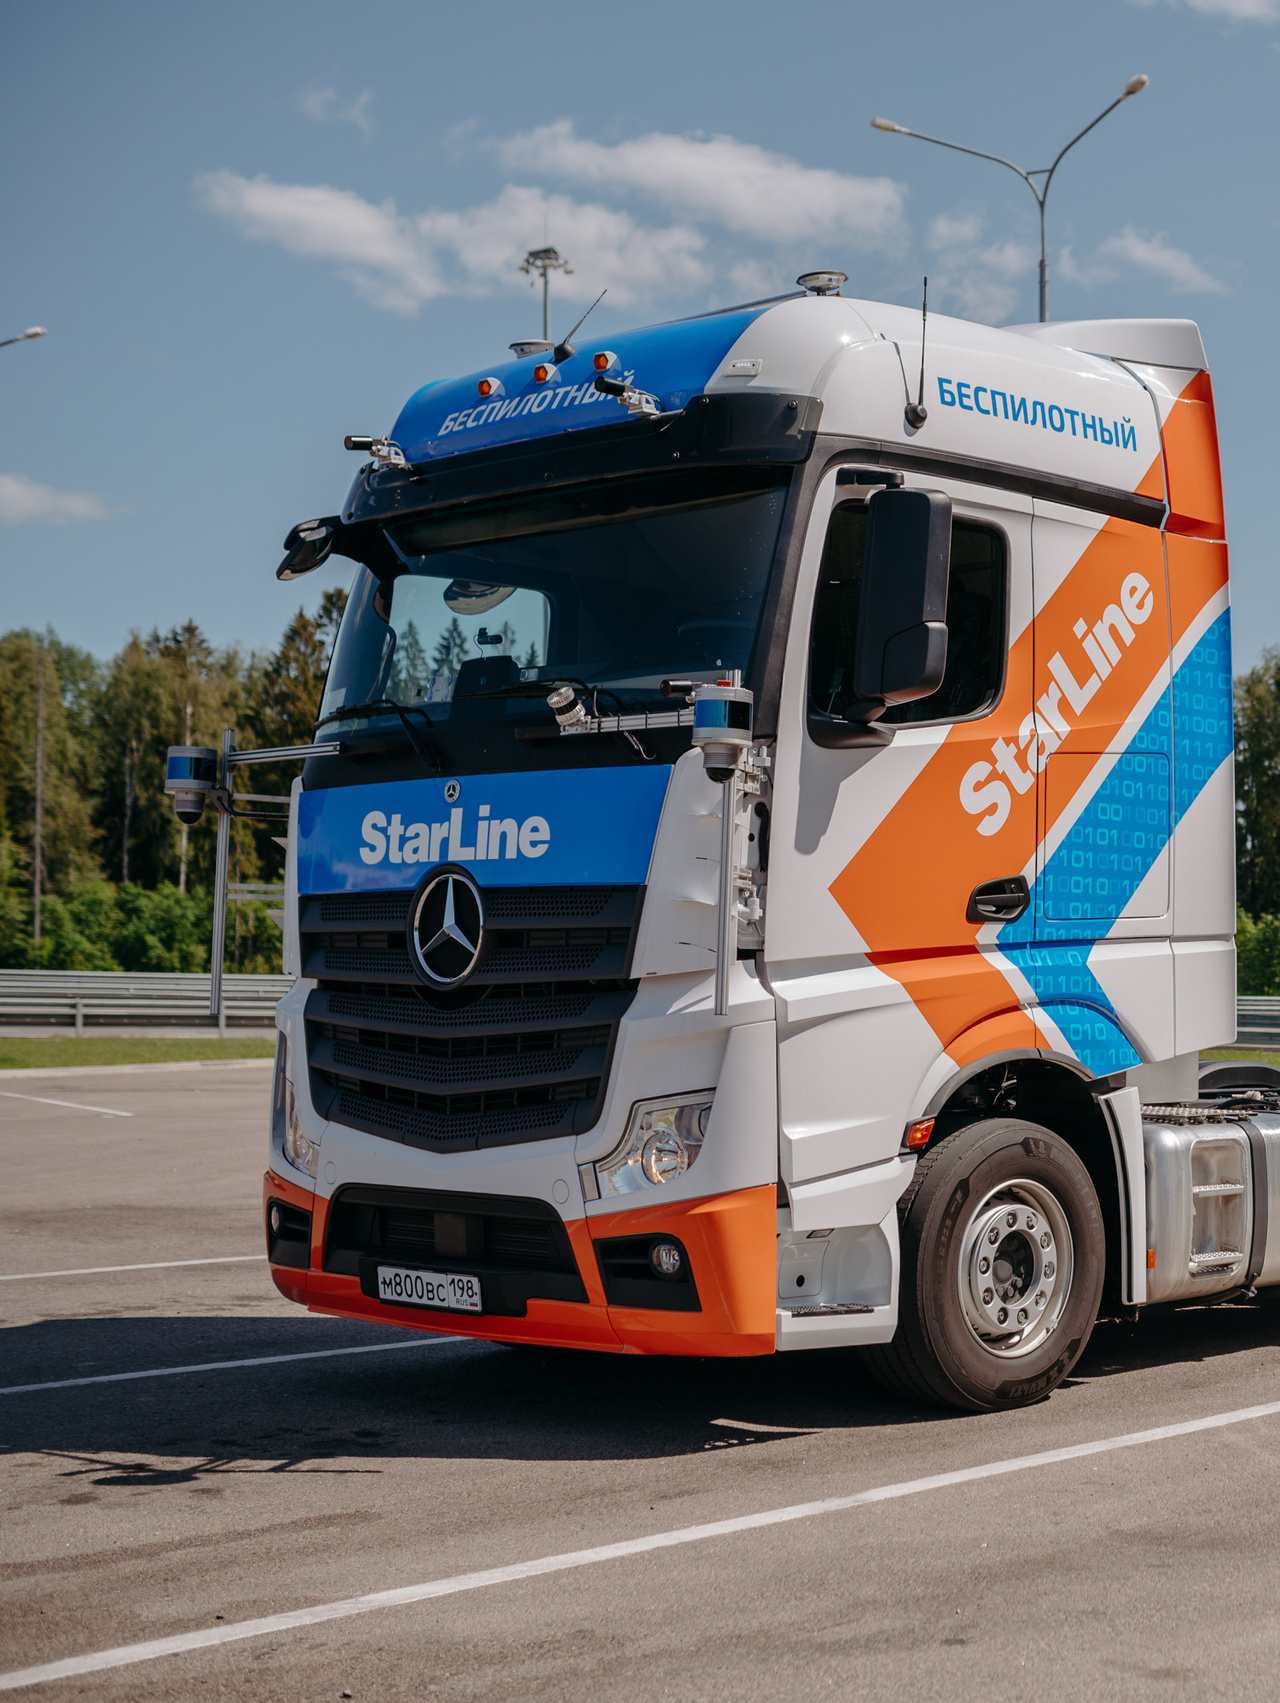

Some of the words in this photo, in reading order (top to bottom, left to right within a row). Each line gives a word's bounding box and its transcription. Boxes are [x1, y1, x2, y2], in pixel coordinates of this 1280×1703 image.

[937, 376, 1137, 452] БЕСПИЛОТНЫЙ
[959, 571, 1154, 837] StarLine
[359, 803, 552, 865] StarLine
[382, 1272, 446, 1302] М800ВС
[449, 1277, 475, 1299] 198
[455, 1297, 469, 1306] RUS
